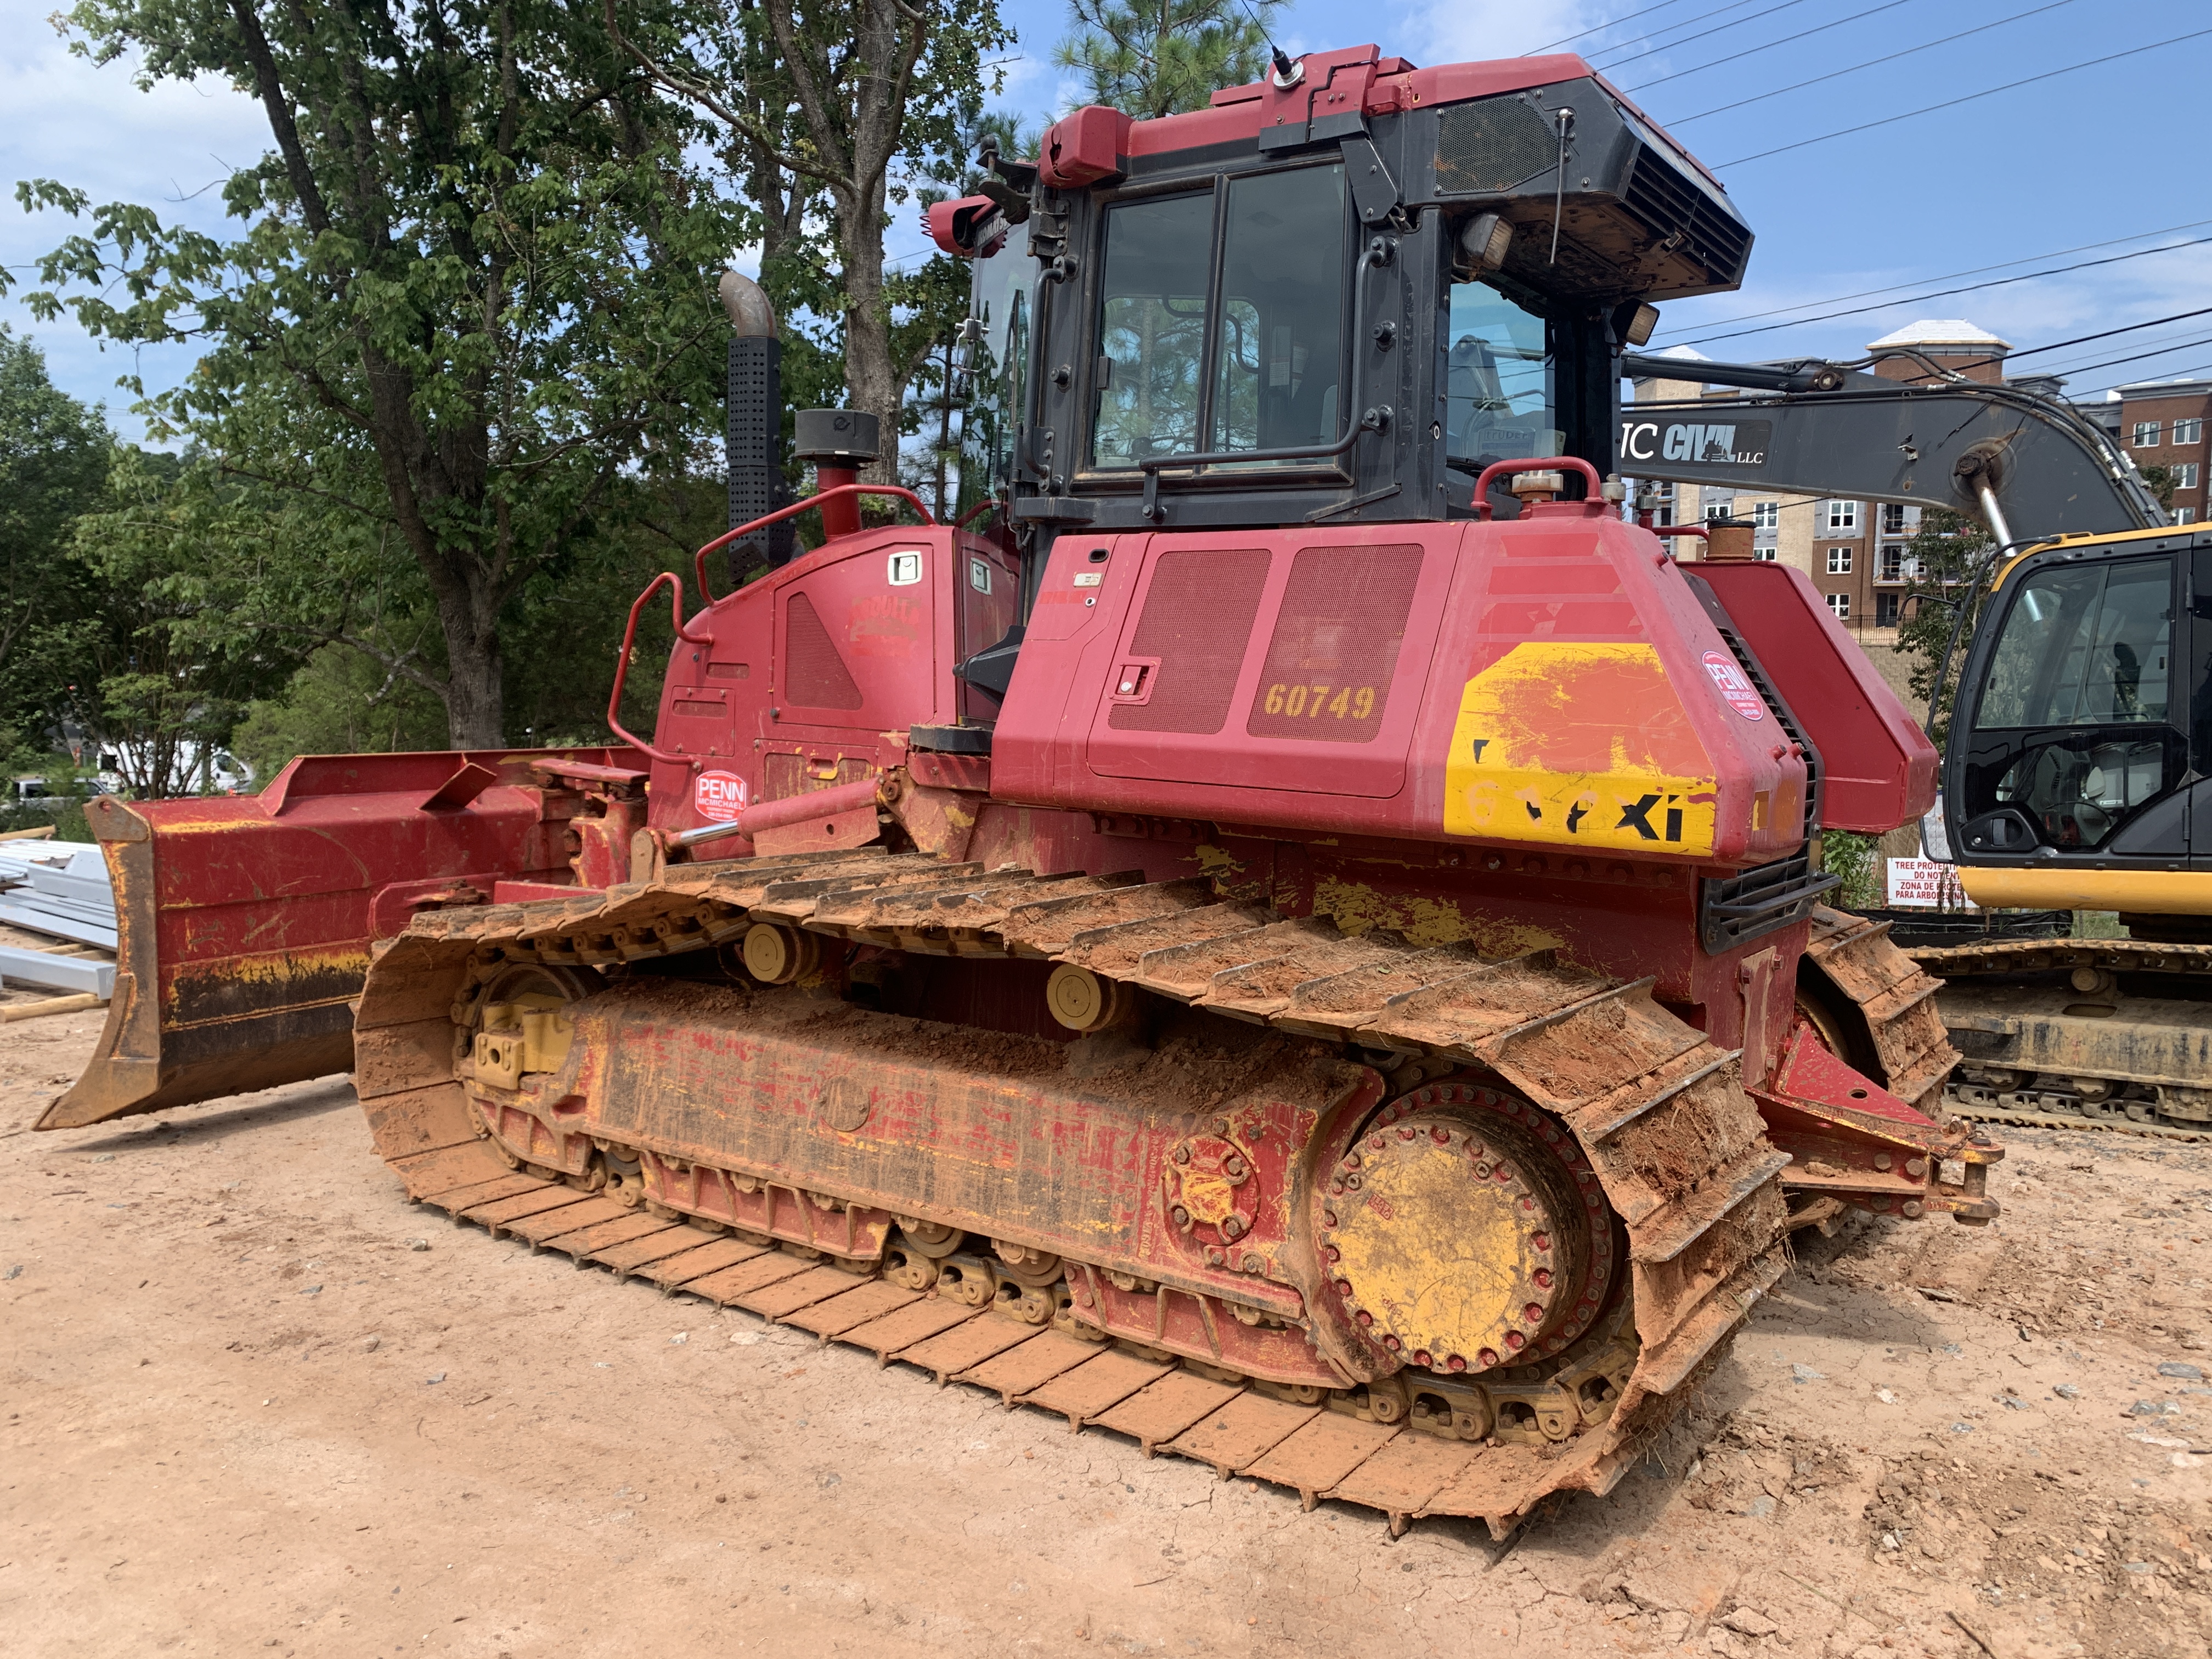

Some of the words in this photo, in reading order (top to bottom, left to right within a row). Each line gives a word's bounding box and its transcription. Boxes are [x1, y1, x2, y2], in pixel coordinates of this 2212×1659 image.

[1662, 424, 1736, 462] CIVIL
[1737, 452, 1763, 464] LLC
[1705, 663, 1750, 690] PENN
[1264, 684, 1375, 719] 60749
[698, 778, 743, 802] PENN
[698, 797, 744, 811] MCMICHAEL
[1895, 861, 1915, 870] TREE
[1900, 882, 1922, 890] ZONA
[1924, 882, 1934, 890] DE
